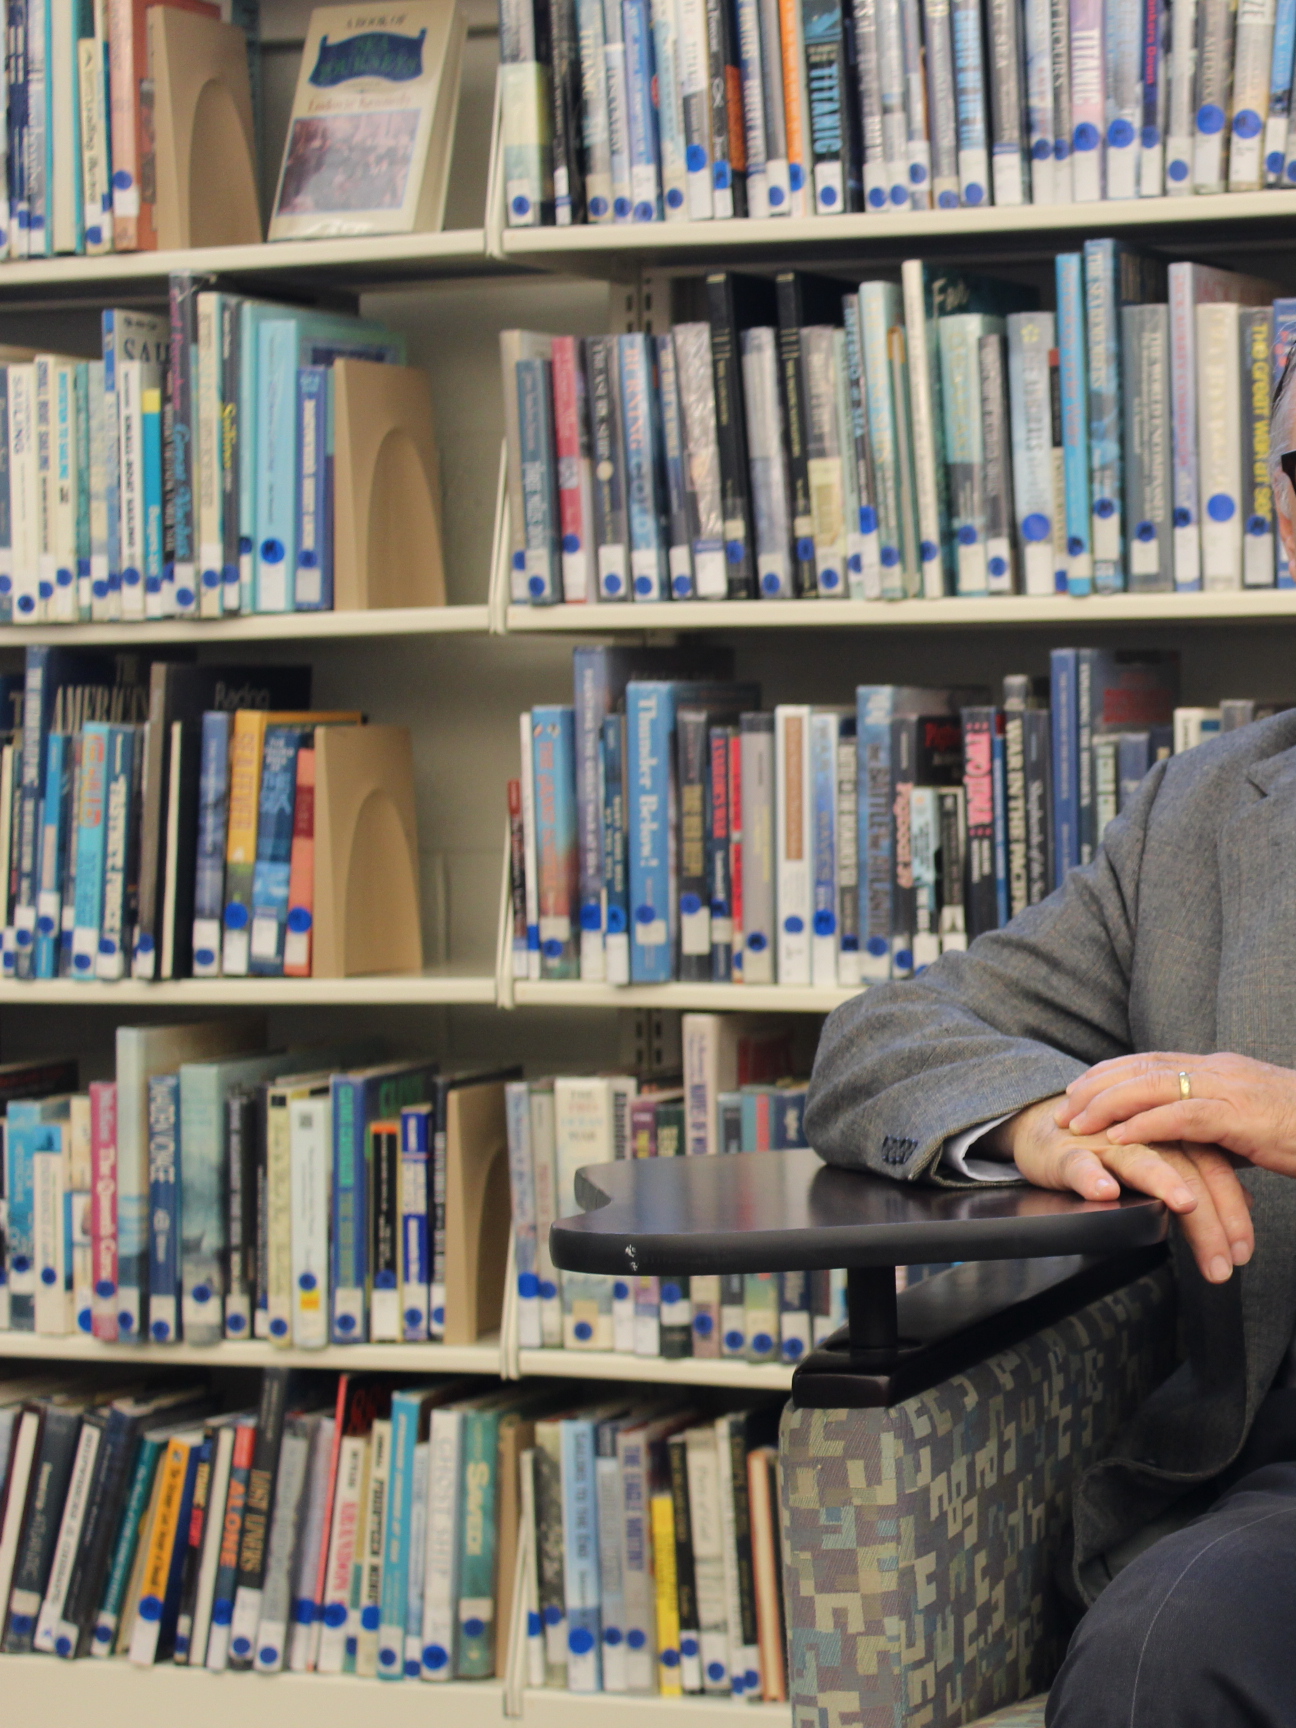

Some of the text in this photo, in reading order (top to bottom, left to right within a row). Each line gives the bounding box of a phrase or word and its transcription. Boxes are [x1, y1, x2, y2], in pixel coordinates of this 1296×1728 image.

[1071, 28, 1102, 106] TITANIC
[1146, 0, 1158, 85] ankers Down
[809, 62, 844, 154] TITANIC
[844, 307, 862, 380] INFERNO
[624, 348, 644, 450] BURNING
[852, 405, 867, 438] SEA
[949, 331, 972, 460] CHESAPEAKE
[1149, 332, 1164, 523] THE WORLD ENCOMPASSED
[584, 734, 597, 757] THE
[967, 730, 991, 774] IWO
[1005, 718, 1024, 769] WAR
[1079, 727, 1091, 753] THE
[232, 772, 254, 831] FEVER
[637, 694, 660, 868] Thunder Below!
[867, 767, 889, 831] BATTLE
[963, 774, 992, 826] JIMA
[1007, 771, 1025, 800] IN
[893, 782, 914, 861] Pigboat
[1007, 800, 1026, 840] THE
[623, 1445, 641, 1467] THE
[219, 1478, 246, 1569] ALONE
[238, 1469, 272, 1574] LOST LINERS
[434, 1436, 453, 1579] GHOST SHIP
[574, 1431, 593, 1560] SAILORS TO THE END
